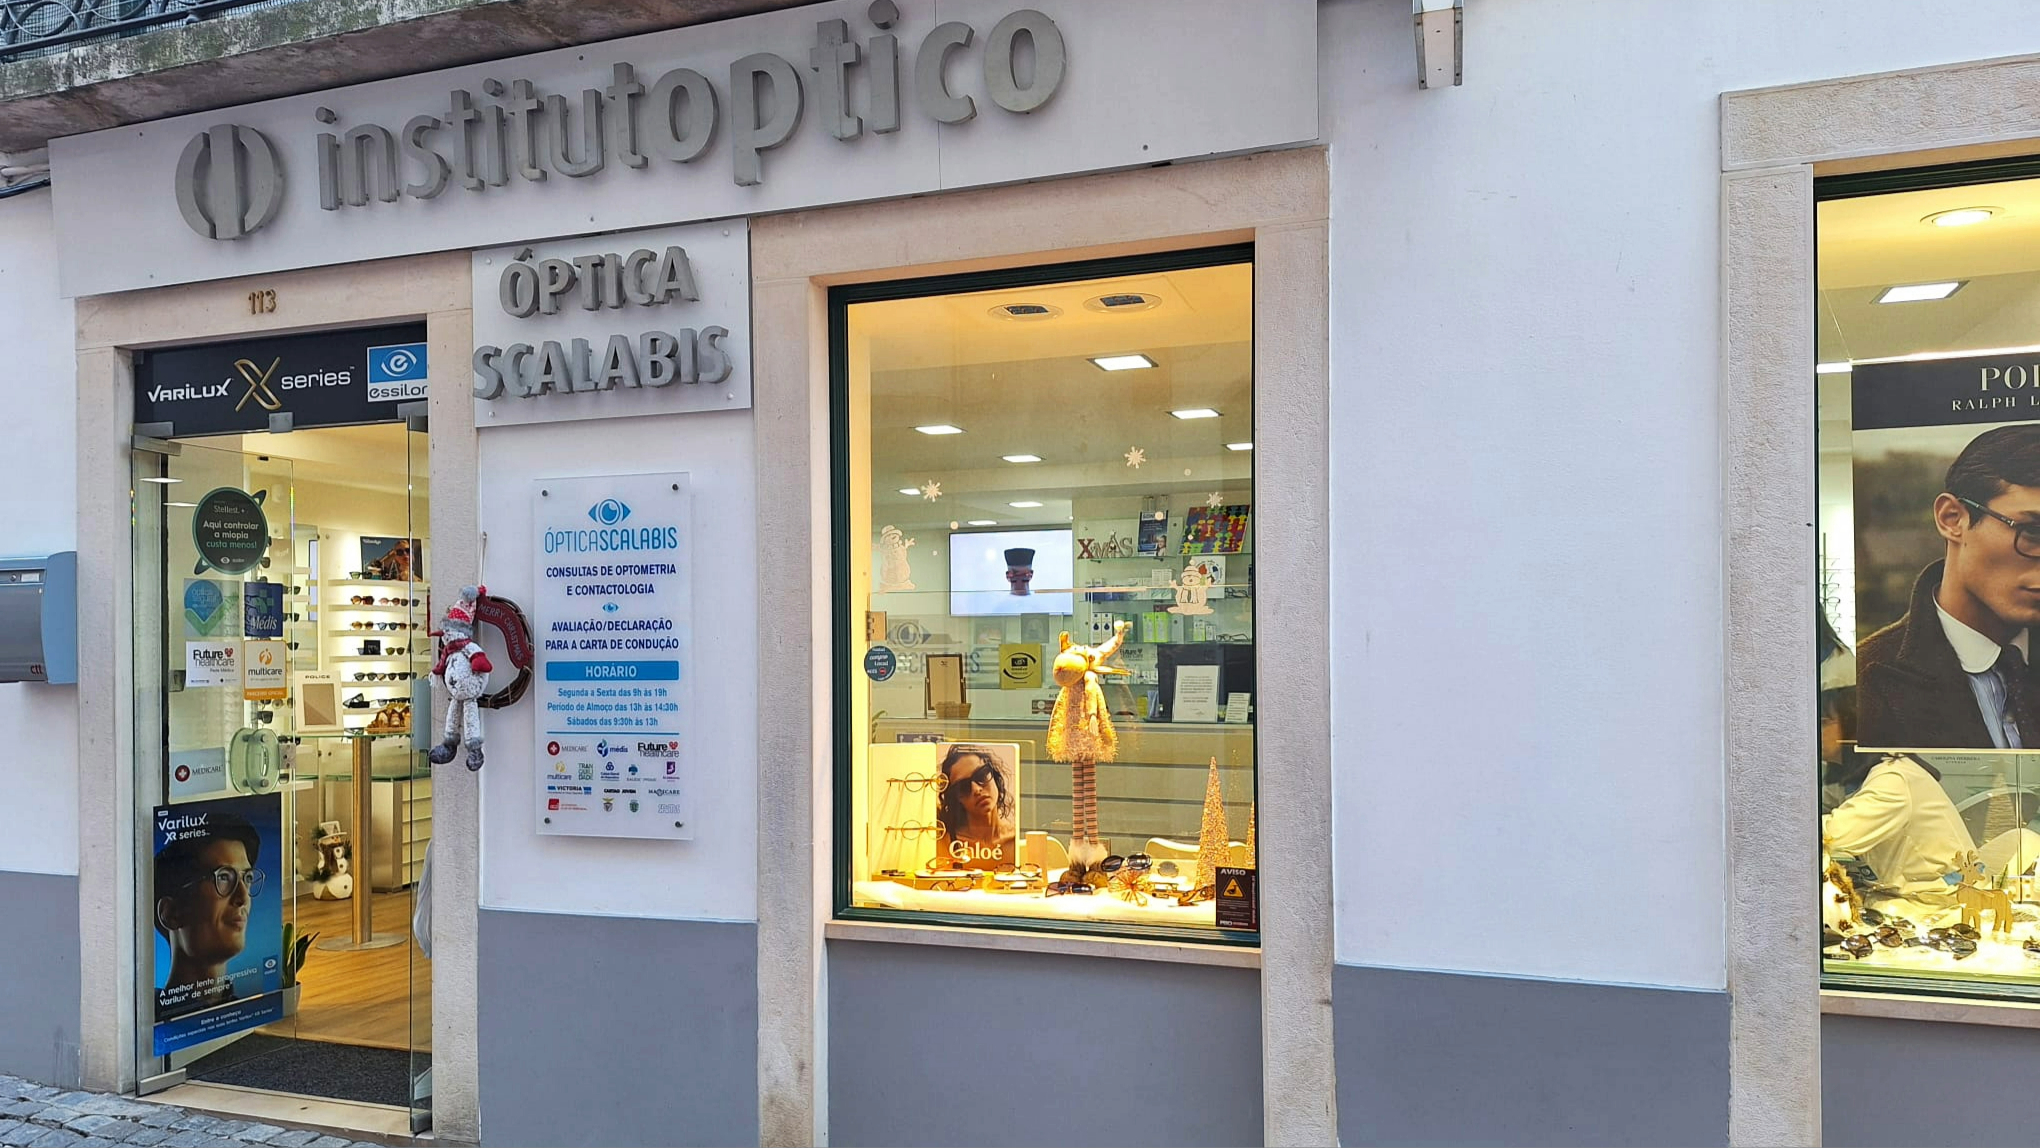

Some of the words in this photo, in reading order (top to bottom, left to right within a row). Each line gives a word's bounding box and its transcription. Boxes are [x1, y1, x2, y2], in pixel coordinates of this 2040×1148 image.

[315, 0, 1067, 211] institutoptico
[498, 246, 700, 318] ÓPTICA
[248, 289, 277, 315] 113
[472, 325, 732, 400] SCALABIS
[281, 369, 351, 390] series
[369, 383, 428, 398] essilor
[1952, 396, 2016, 411] RALPH
[203, 520, 222, 530] Aqui
[223, 521, 259, 530] controlar
[222, 531, 249, 540] miopia
[206, 540, 228, 548] custa
[546, 566, 598, 577] CONSULTAS
[600, 565, 613, 576] DE
[615, 564, 677, 576] OPTOMETRIA
[566, 585, 573, 596] E
[575, 583, 655, 596] CONTACTOLOGIA
[478, 604, 506, 618] MERRY
[251, 614, 278, 630] Médis
[552, 618, 673, 633] AVALIAÇÃO/DECLARAÇÃO
[504, 617, 524, 661] CHRISTMAS
[545, 640, 569, 651] PARA
[571, 639, 577, 650] A
[579, 639, 608, 650] CARTA
[610, 639, 623, 649] DE
[624, 636, 679, 651] CONDUÇÃO
[193, 649, 224, 660] Future
[194, 658, 235, 667] healthcare
[248, 667, 283, 676] multicare
[585, 662, 637, 678] HORÁRIO
[558, 688, 589, 698] Segunda
[590, 689, 595, 697] a
[596, 688, 617, 697] Sexta
[618, 688, 631, 697] das
[632, 688, 642, 697] 9h
[654, 688, 668, 697] 19h
[547, 702, 575, 712] Período
[576, 703, 585, 711] de
[586, 702, 613, 713] Almoço
[614, 703, 628, 711] das
[629, 703, 642, 712] 13h
[655, 703, 679, 712] 14:30h
[566, 717, 598, 726] Sábados
[598, 717, 612, 726] das
[613, 717, 633, 726] 9:30h
[645, 718, 658, 726] 13h
[637, 742, 668, 752] Future
[639, 749, 680, 758] healthcare
[192, 765, 222, 775] MEDICARE
[158, 813, 208, 831] Varilux
[163, 831, 177, 845] XR
[949, 840, 1003, 861] Chloé
[1220, 868, 1246, 876] AVISO
[159, 990, 166, 998] A
[168, 983, 195, 995] melhor
[196, 977, 214, 988] lente
[216, 967, 258, 983] progressiva
[191, 988, 202, 999] de
